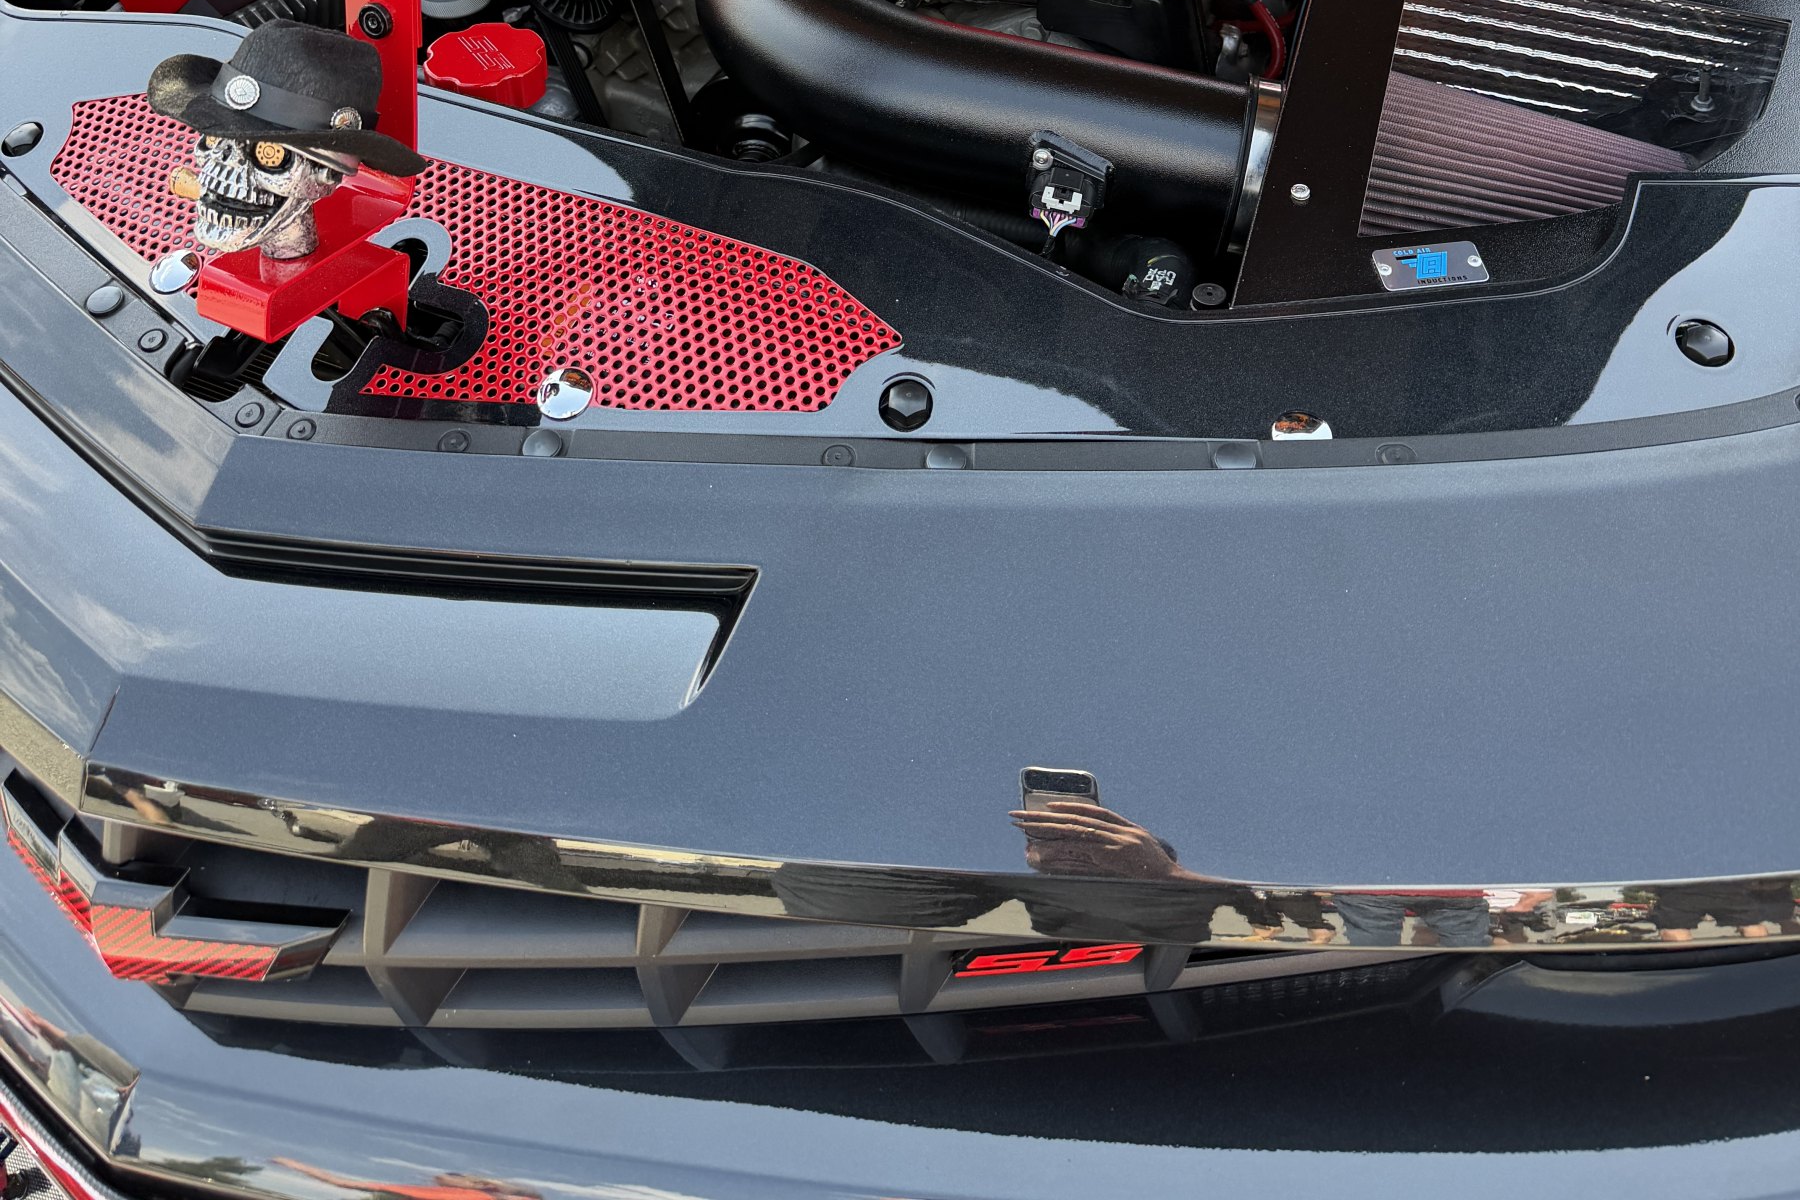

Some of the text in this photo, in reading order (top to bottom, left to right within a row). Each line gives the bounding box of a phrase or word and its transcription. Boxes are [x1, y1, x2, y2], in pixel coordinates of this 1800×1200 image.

[1392, 247, 1432, 257] COLD AIR
[1416, 275, 1468, 285] INDUCTIONS
[954, 943, 1146, 978] SS
